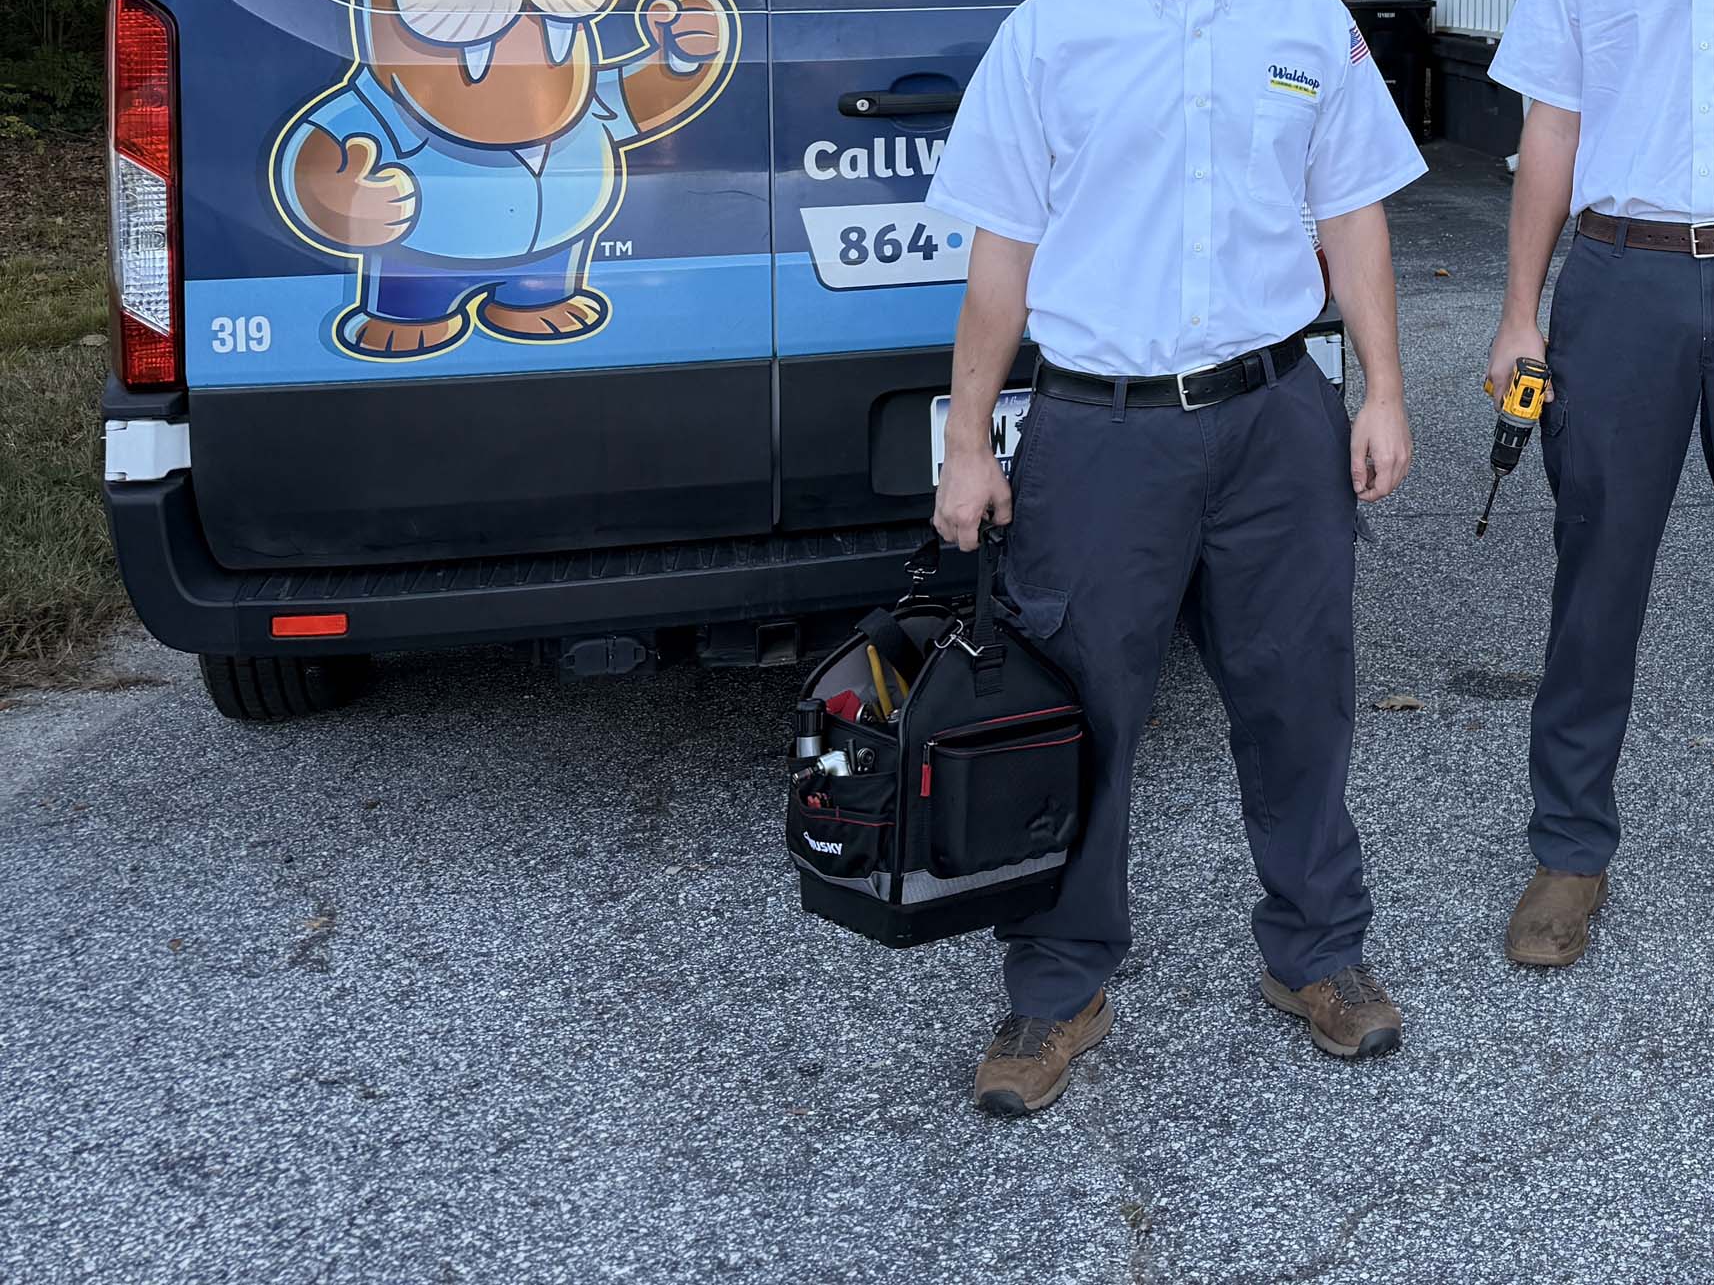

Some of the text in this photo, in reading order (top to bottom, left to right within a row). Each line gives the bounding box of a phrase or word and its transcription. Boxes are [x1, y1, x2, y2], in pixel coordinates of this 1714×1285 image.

[1268, 65, 1321, 90] Waldrop
[601, 241, 633, 256] TM
[839, 223, 939, 267] 864
[211, 316, 271, 353] 319
